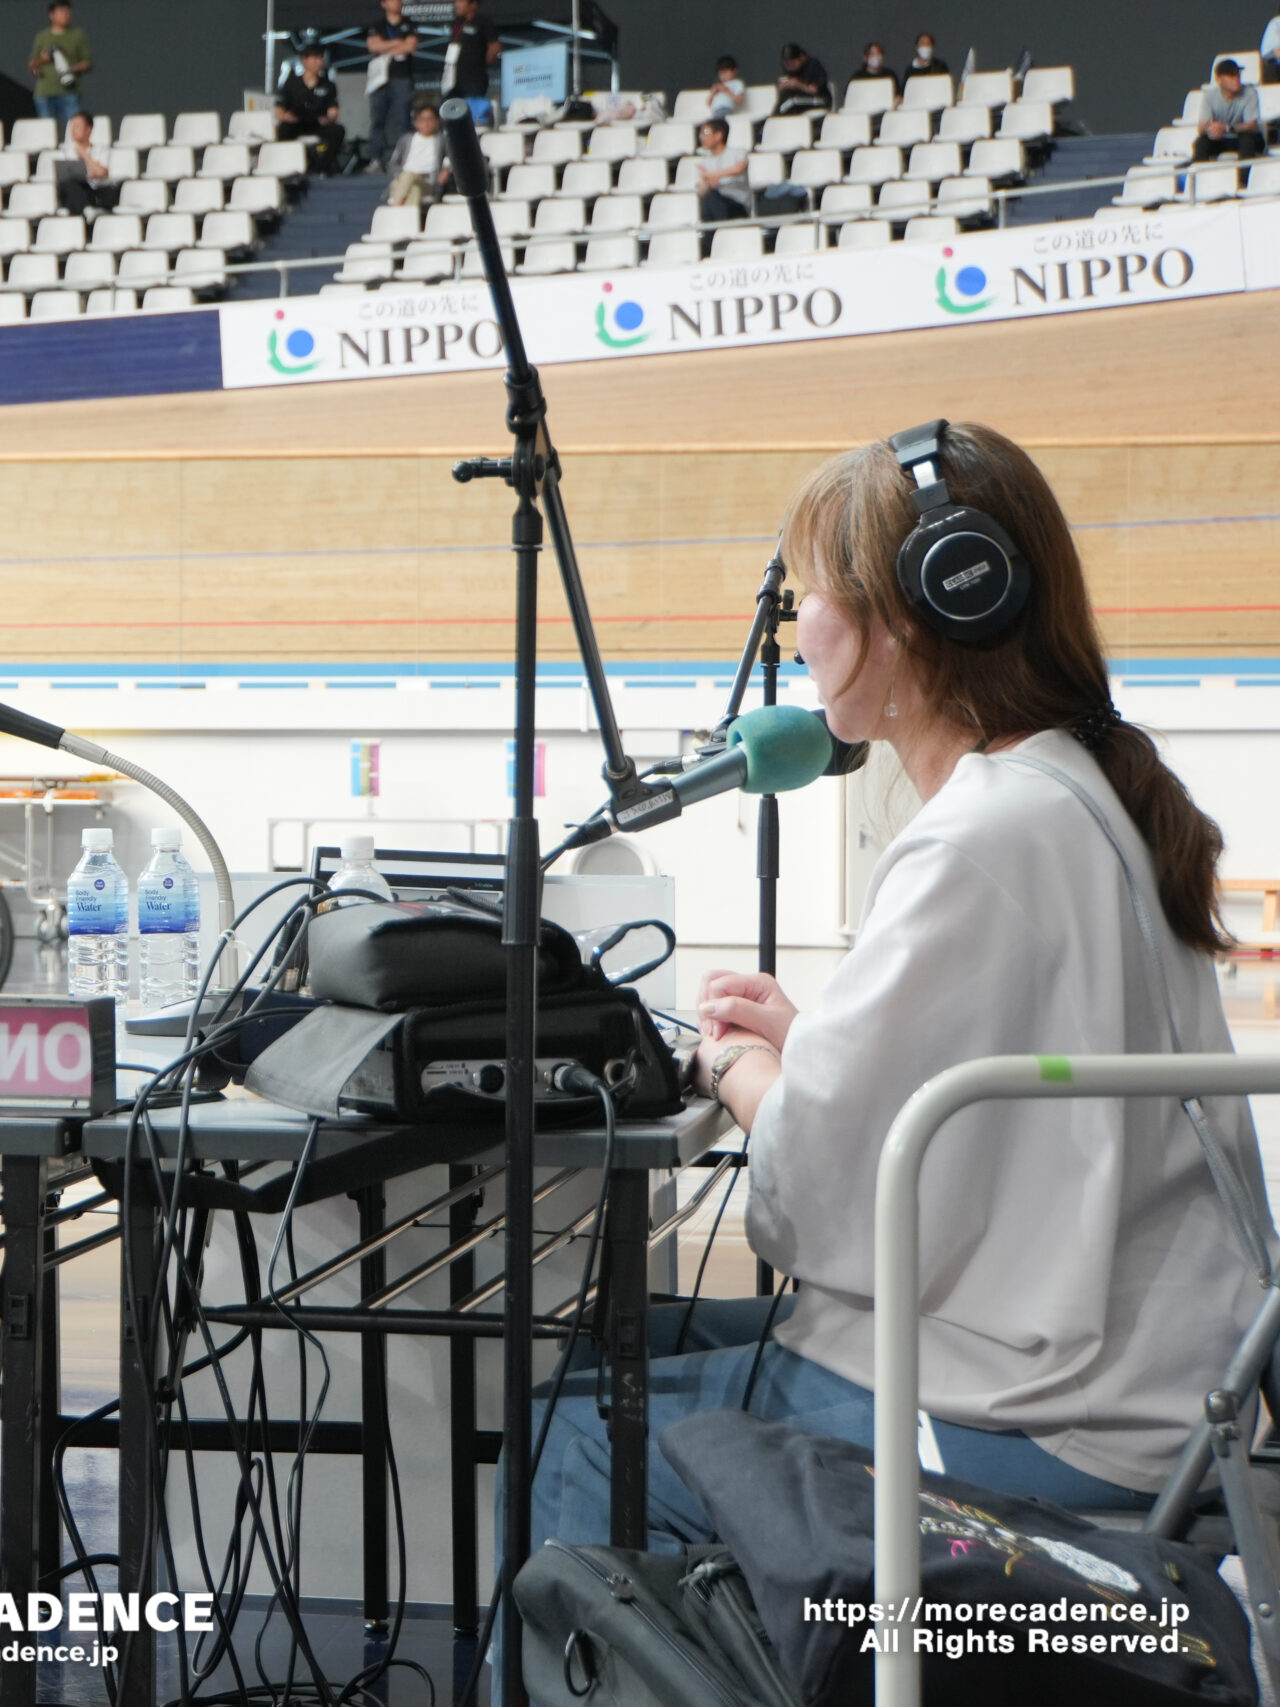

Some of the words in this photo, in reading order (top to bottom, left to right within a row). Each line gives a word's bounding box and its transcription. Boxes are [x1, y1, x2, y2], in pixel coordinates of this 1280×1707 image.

[1034, 223, 1164, 253] この道の先に
[689, 263, 814, 291] この道の先に
[1010, 247, 1194, 305] NIPPO
[358, 294, 479, 319] この道の先に
[669, 287, 842, 341] NIPPO
[338, 319, 505, 369] NIPPO
[77, 902, 102, 912] Water
[146, 902, 171, 910] Water
